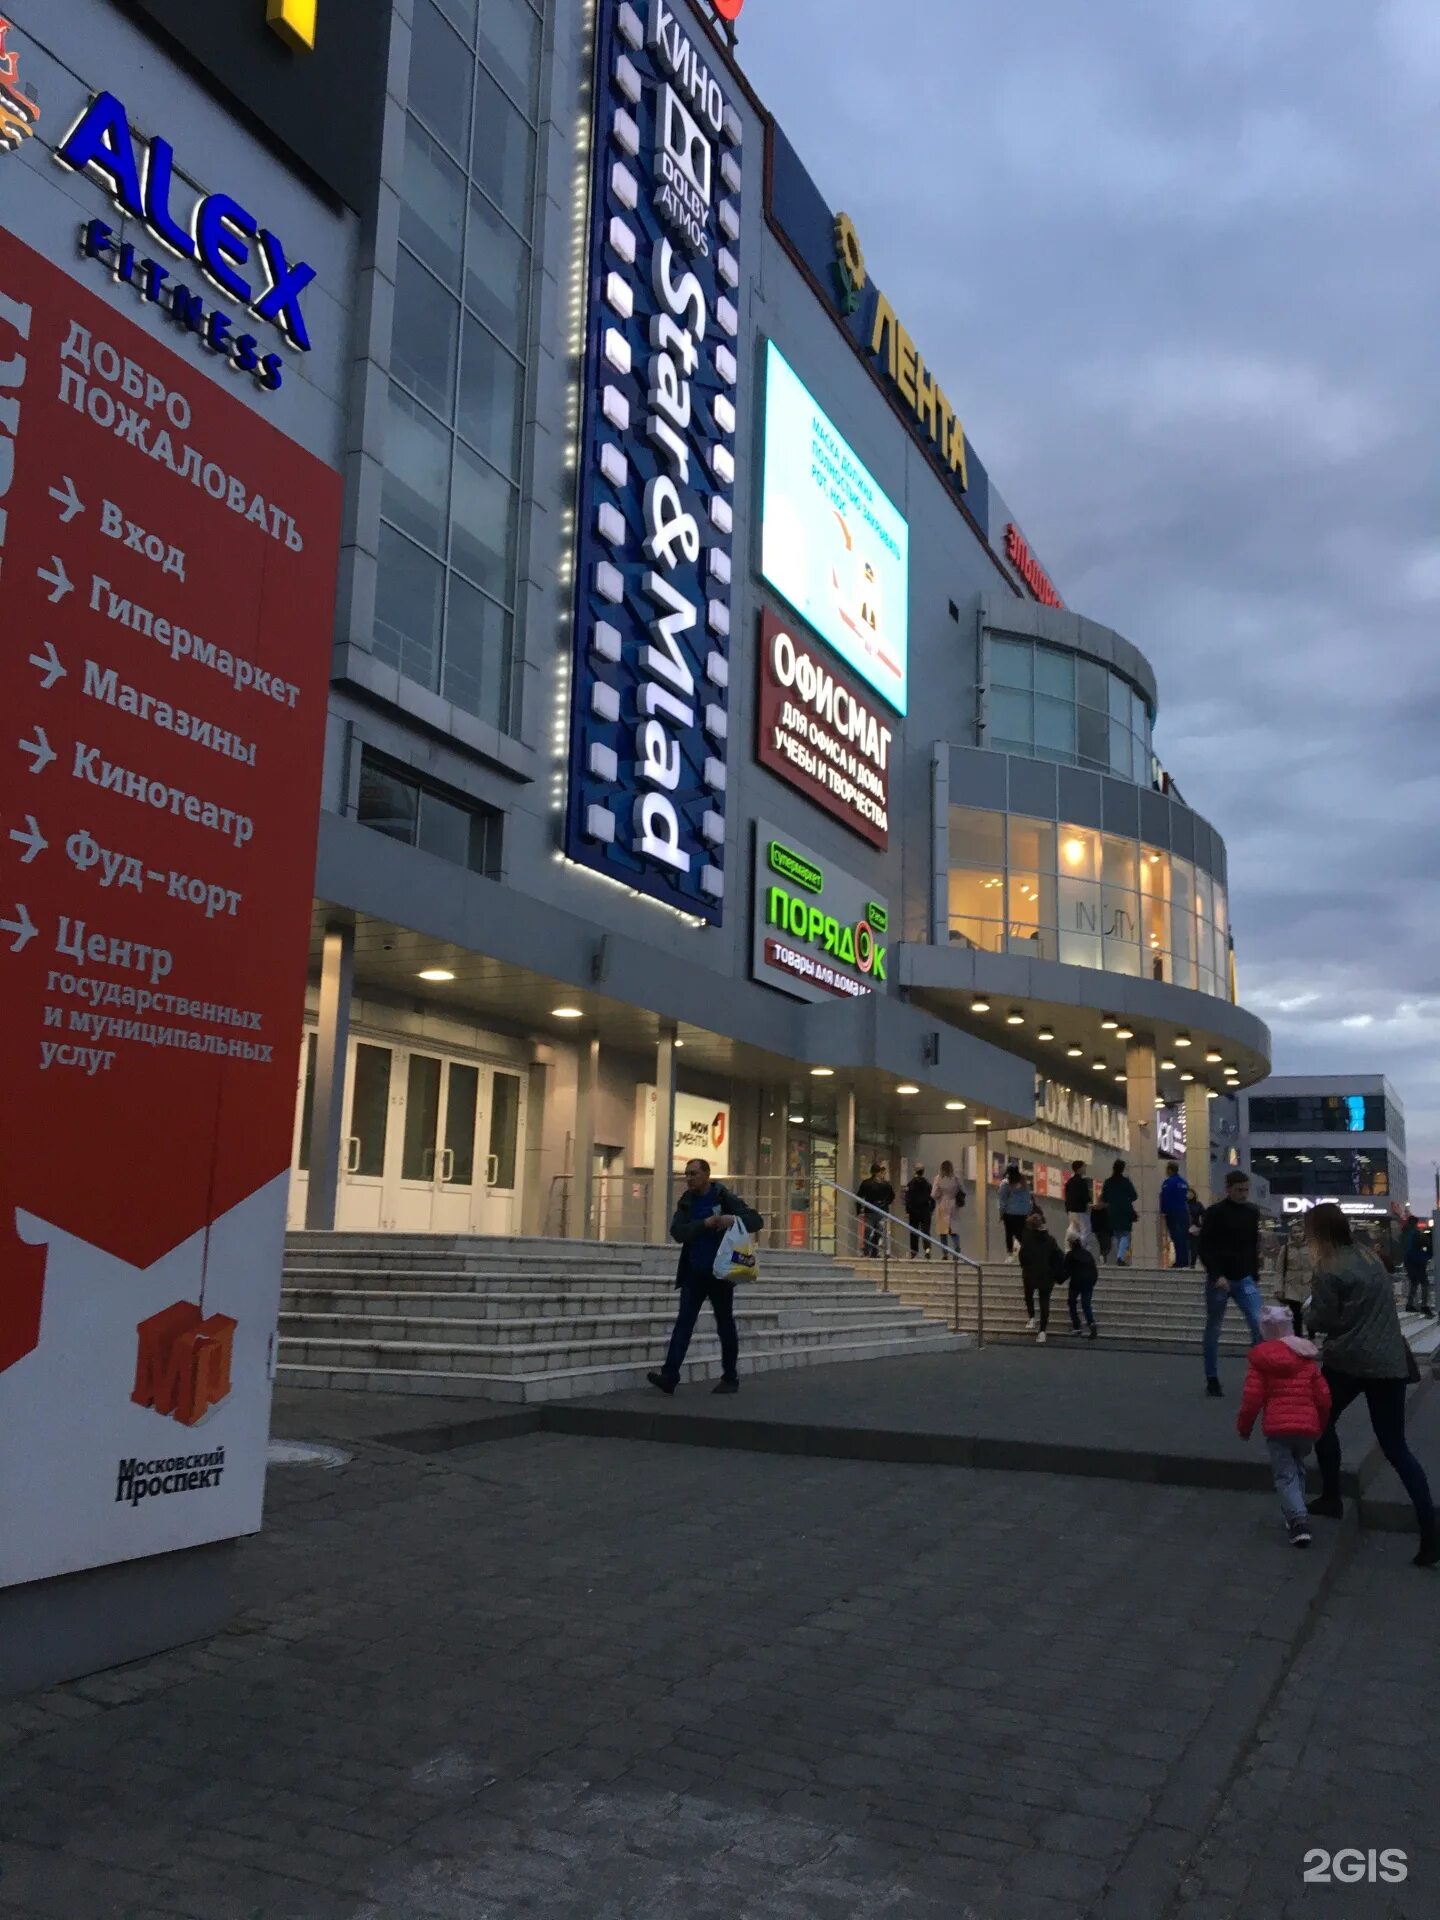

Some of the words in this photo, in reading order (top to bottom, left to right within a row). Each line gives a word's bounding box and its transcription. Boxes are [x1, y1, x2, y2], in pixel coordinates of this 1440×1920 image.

[655, 0, 723, 133] КИНО
[57, 91, 317, 351] ALEX
[661, 152, 709, 230] DOLBY
[661, 184, 709, 257] ATMOS
[83, 219, 283, 390] FITNESS
[61, 320, 191, 430] ДОБРО
[869, 291, 969, 493] ЛЕНТА
[58, 363, 304, 552] ПОЖАЛОВАТЬ
[100, 499, 186, 583] Вход
[89, 574, 301, 710] Гипермаркет
[82, 659, 257, 766] Магазины
[773, 632, 892, 770] ОФИСМАГ
[782, 701, 807, 735] ДЛЯ
[808, 724, 848, 770] ОФИСА
[848, 755, 856, 776] И
[72, 741, 255, 848] Кинотеатр
[774, 727, 817, 776] УЧЕБЫ
[817, 762, 827, 784] И
[827, 768, 888, 832] ТВОРЧЕСТВА
[65, 828, 243, 919] Фуд-корт
[55, 916, 173, 984] Центр
[770, 886, 888, 980] ПОРЯДОК
[43, 1006, 62, 1028] и
[68, 1009, 273, 1063] муниципальных
[47, 971, 262, 1030] государственных
[40, 1041, 116, 1076] услуг
[115, 1466, 224, 1507] Проспект
[119, 1446, 225, 1478] Московский
